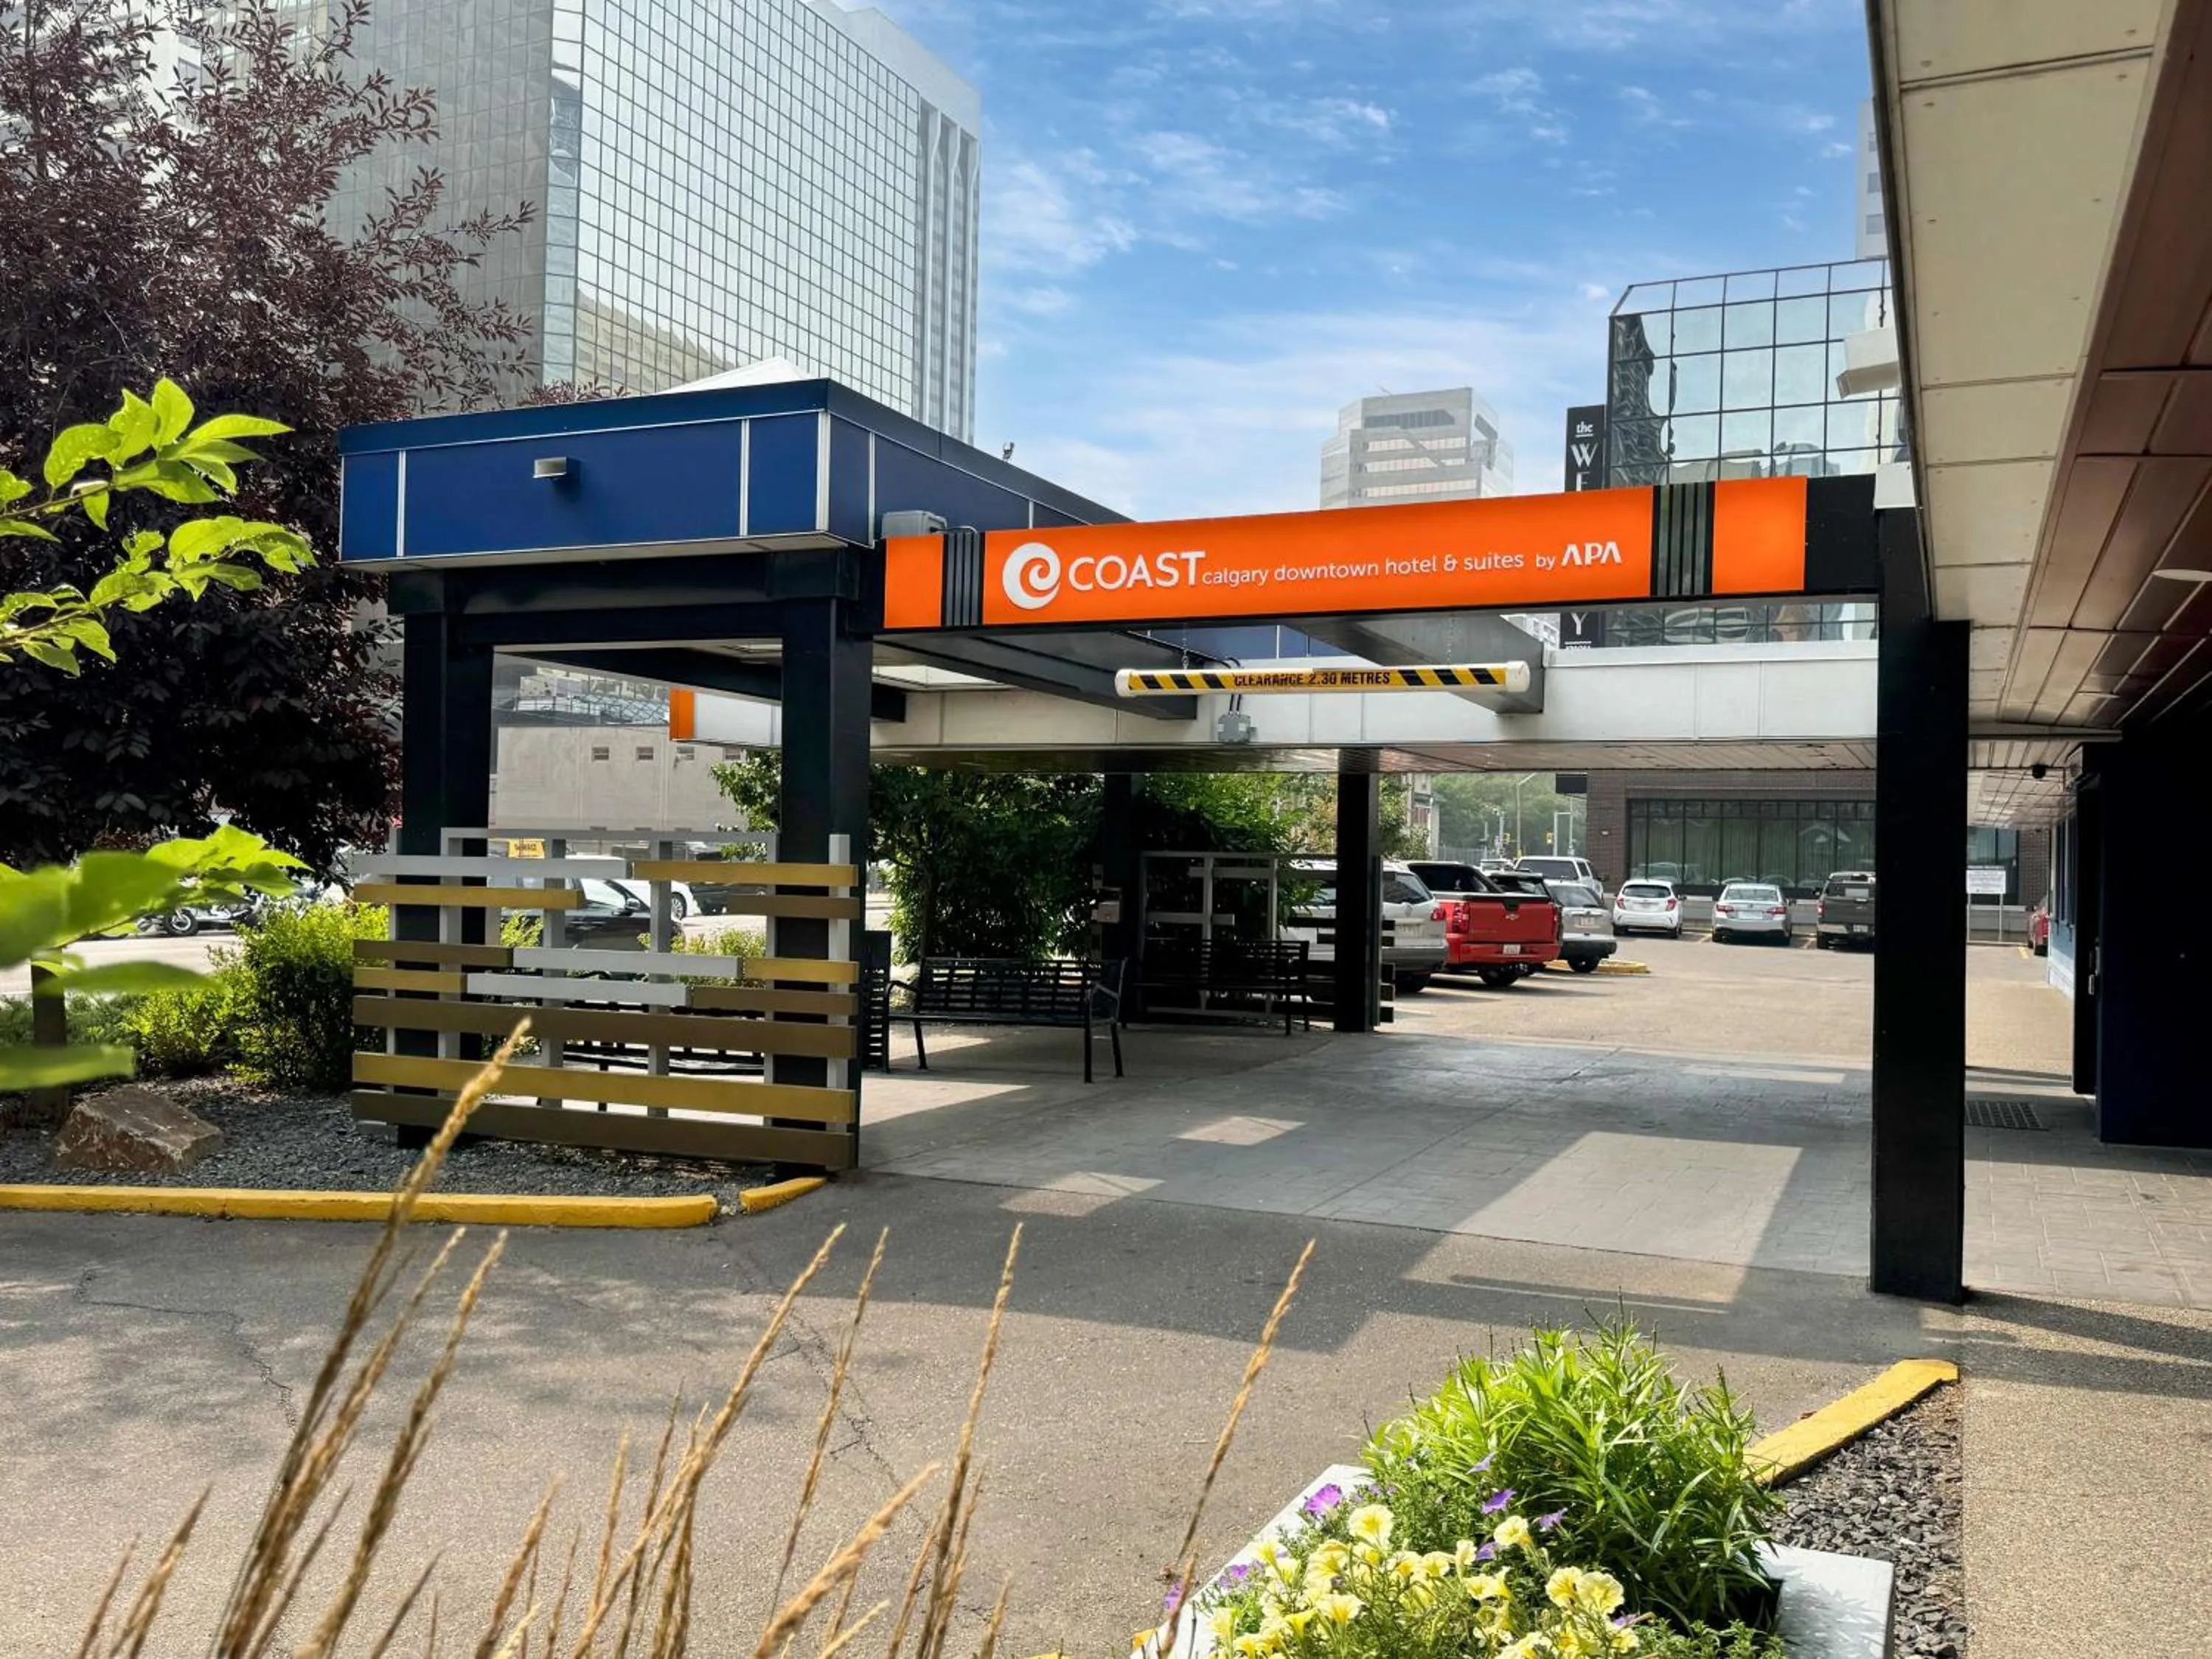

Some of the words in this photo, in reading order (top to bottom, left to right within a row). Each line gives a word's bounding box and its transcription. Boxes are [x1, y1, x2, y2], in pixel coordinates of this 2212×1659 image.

[1068, 551, 1206, 591] COAST
[1202, 568, 1267, 588] calgary
[1273, 564, 1379, 581] downtown
[1385, 555, 1436, 574] hotel
[1444, 554, 1457, 572] &
[1464, 553, 1523, 571] suites
[1536, 554, 1556, 569] by
[1561, 541, 1621, 566] APA
[1234, 672, 1304, 686] CLEARANCE
[1309, 672, 1337, 684] 2.30
[1340, 672, 1391, 684] METRES
